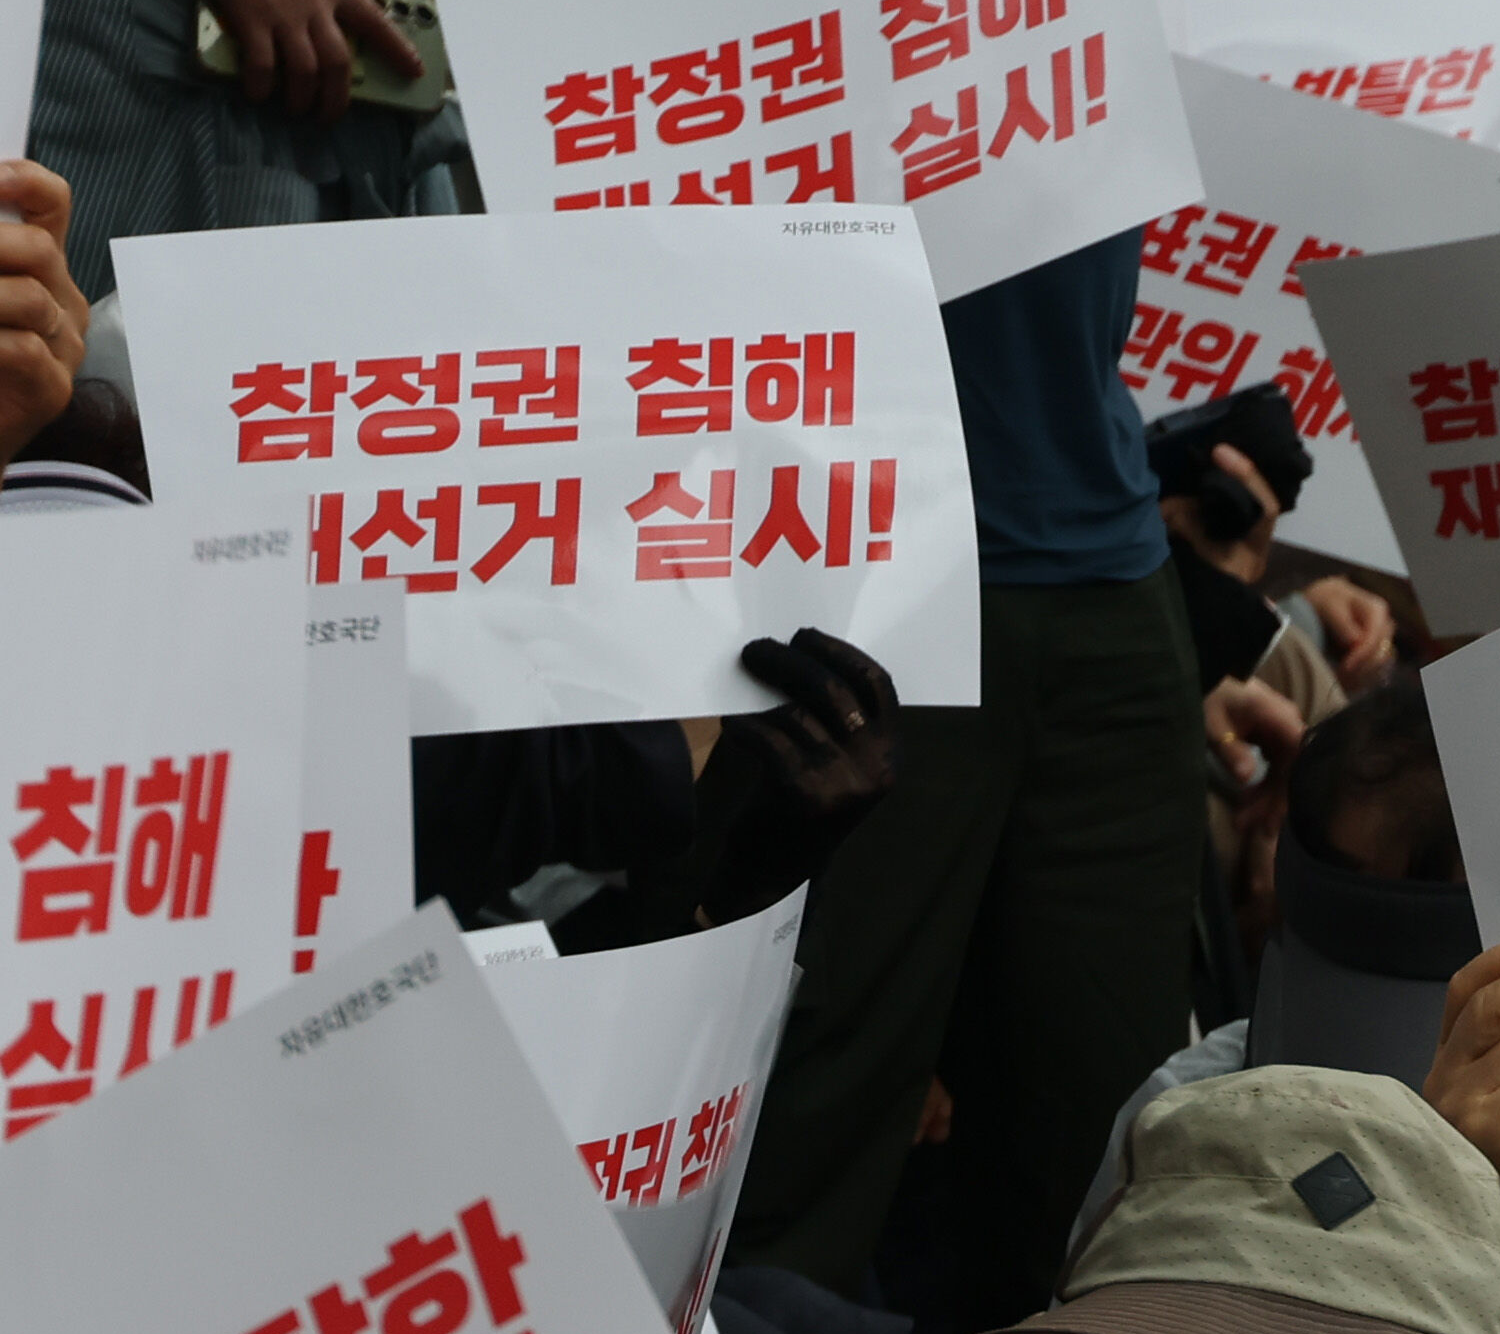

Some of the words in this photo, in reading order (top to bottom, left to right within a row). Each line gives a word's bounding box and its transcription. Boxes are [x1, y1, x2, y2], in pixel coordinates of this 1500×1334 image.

[546, 11, 844, 167] 참정권
[892, 27, 1106, 202] 실시!
[783, 221, 895, 235] 자유대한호국단
[1141, 206, 1277, 295] 표권
[231, 346, 580, 462] 참정권
[628, 333, 854, 435] 침해
[1121, 304, 1259, 400] 관위
[627, 459, 896, 579] 실시!
[13, 752, 229, 941] 침해
[279, 950, 443, 1057] 자유대한호국단
